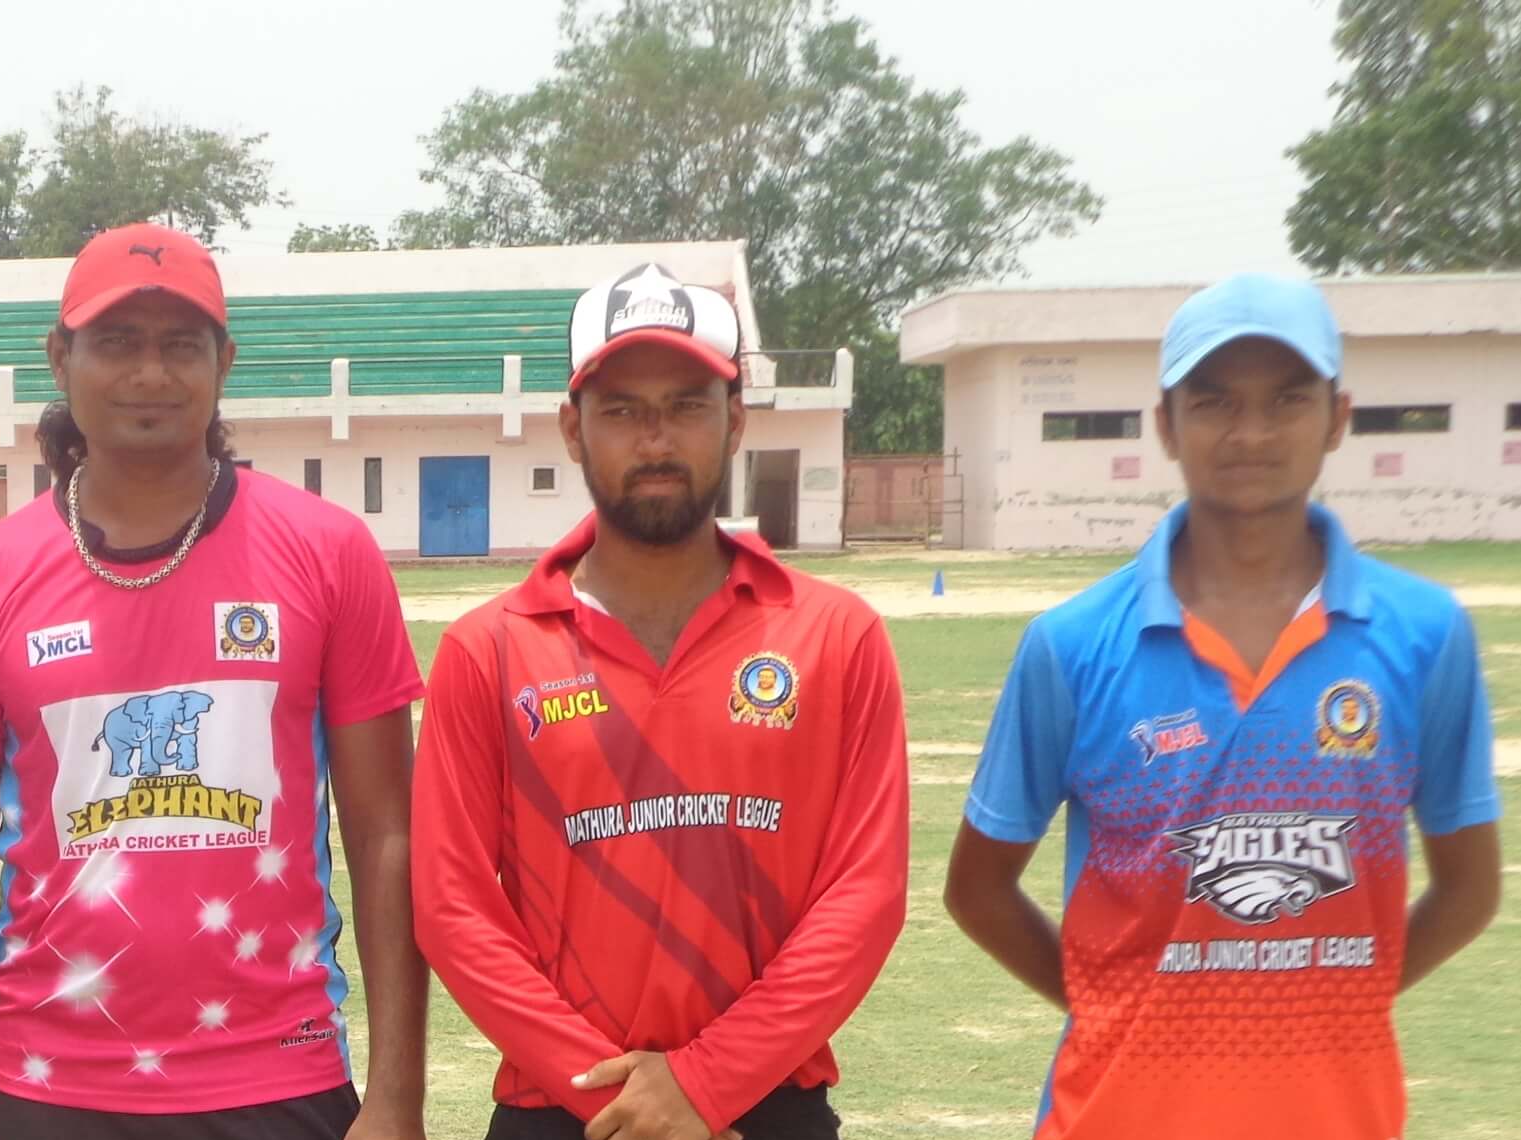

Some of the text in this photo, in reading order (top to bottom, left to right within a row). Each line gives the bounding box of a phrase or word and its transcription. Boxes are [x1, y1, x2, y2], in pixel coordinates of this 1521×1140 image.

[47, 635, 92, 657] MCL
[542, 689, 608, 724] MJCL
[564, 803, 626, 847] MATHURA
[627, 796, 676, 834] JUNIOR
[676, 794, 731, 826] CRICKET
[125, 834, 200, 849] CRICKET
[205, 830, 267, 847] LEAGUE
[1184, 817, 1354, 881] EAGLES
[1203, 939, 1257, 971] JUNIOR
[1258, 937, 1315, 971] CRICKET
[1316, 936, 1375, 967] LEAGUE
